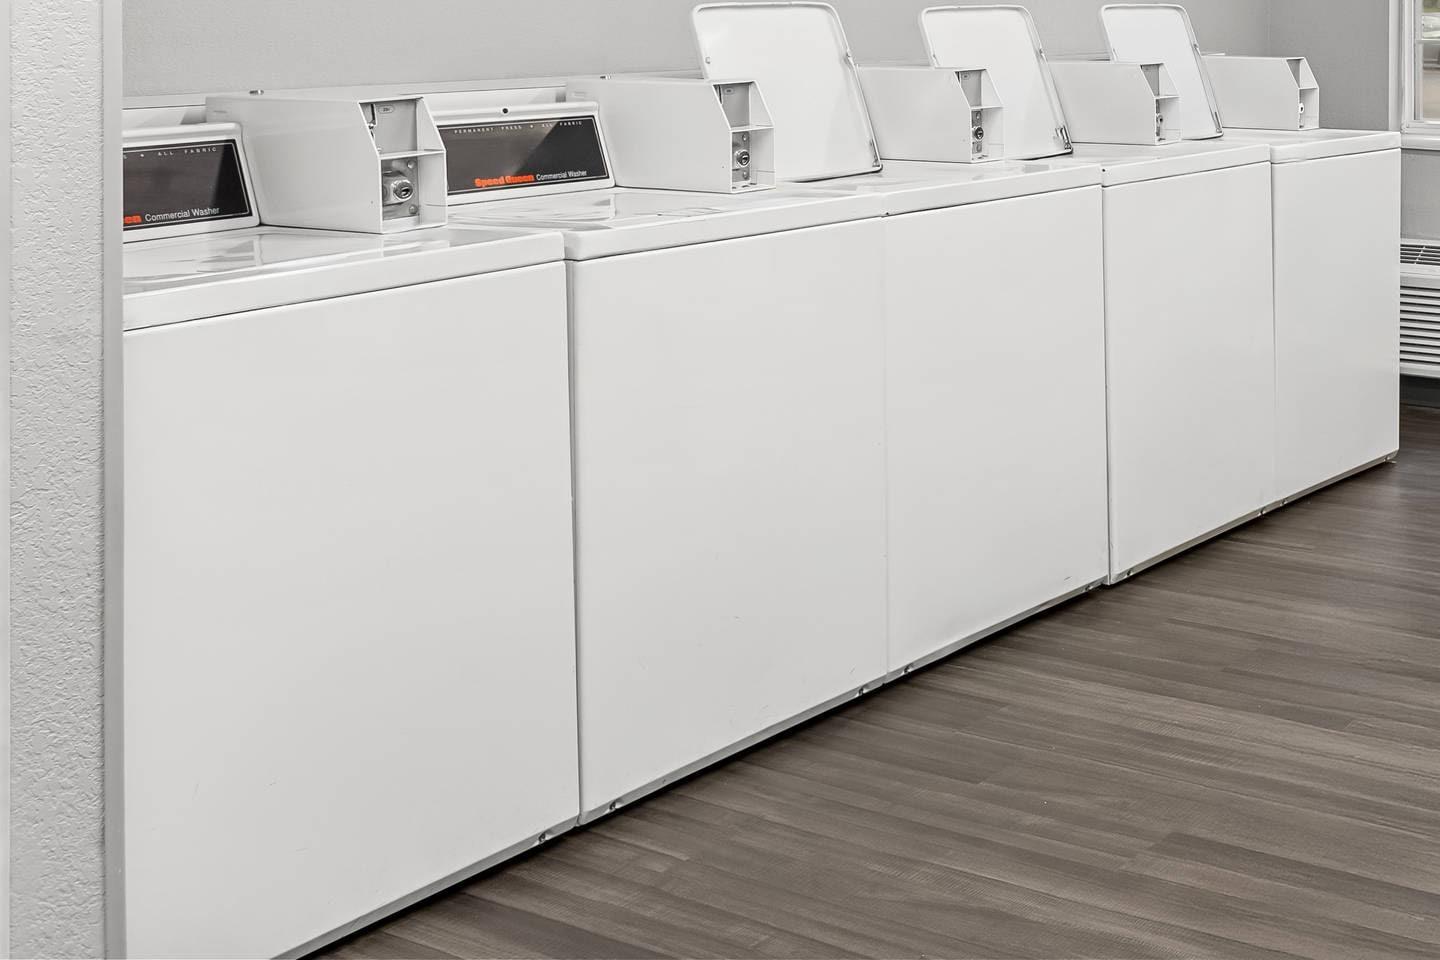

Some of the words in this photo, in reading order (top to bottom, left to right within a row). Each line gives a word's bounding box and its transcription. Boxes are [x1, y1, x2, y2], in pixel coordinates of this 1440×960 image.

[184, 146, 217, 154] FABRIC
[474, 177, 504, 188] Speed
[505, 174, 535, 184] Queen
[536, 172, 567, 181] Commercial
[145, 209, 190, 222] Commercial
[191, 207, 219, 217] Washer
